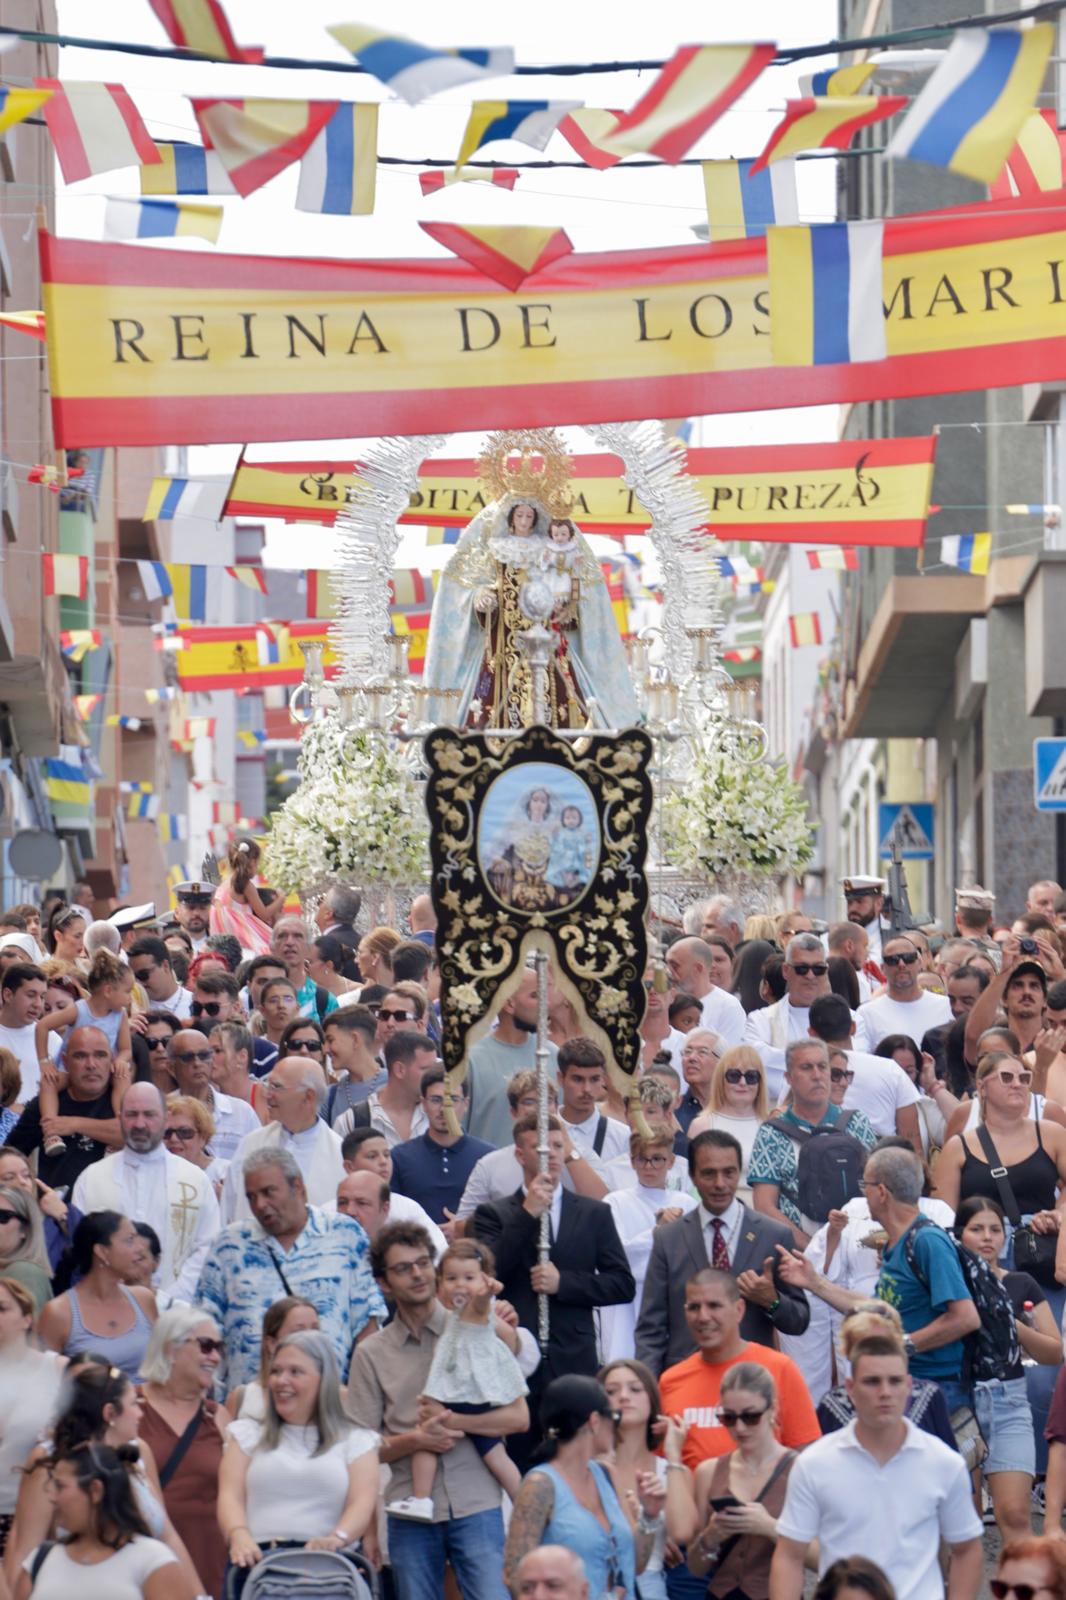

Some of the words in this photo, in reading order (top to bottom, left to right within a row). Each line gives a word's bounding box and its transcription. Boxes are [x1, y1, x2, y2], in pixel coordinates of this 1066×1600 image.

[109, 309, 391, 363] REINA
[455, 303, 557, 352] DE
[711, 480, 868, 511] PUREZA
